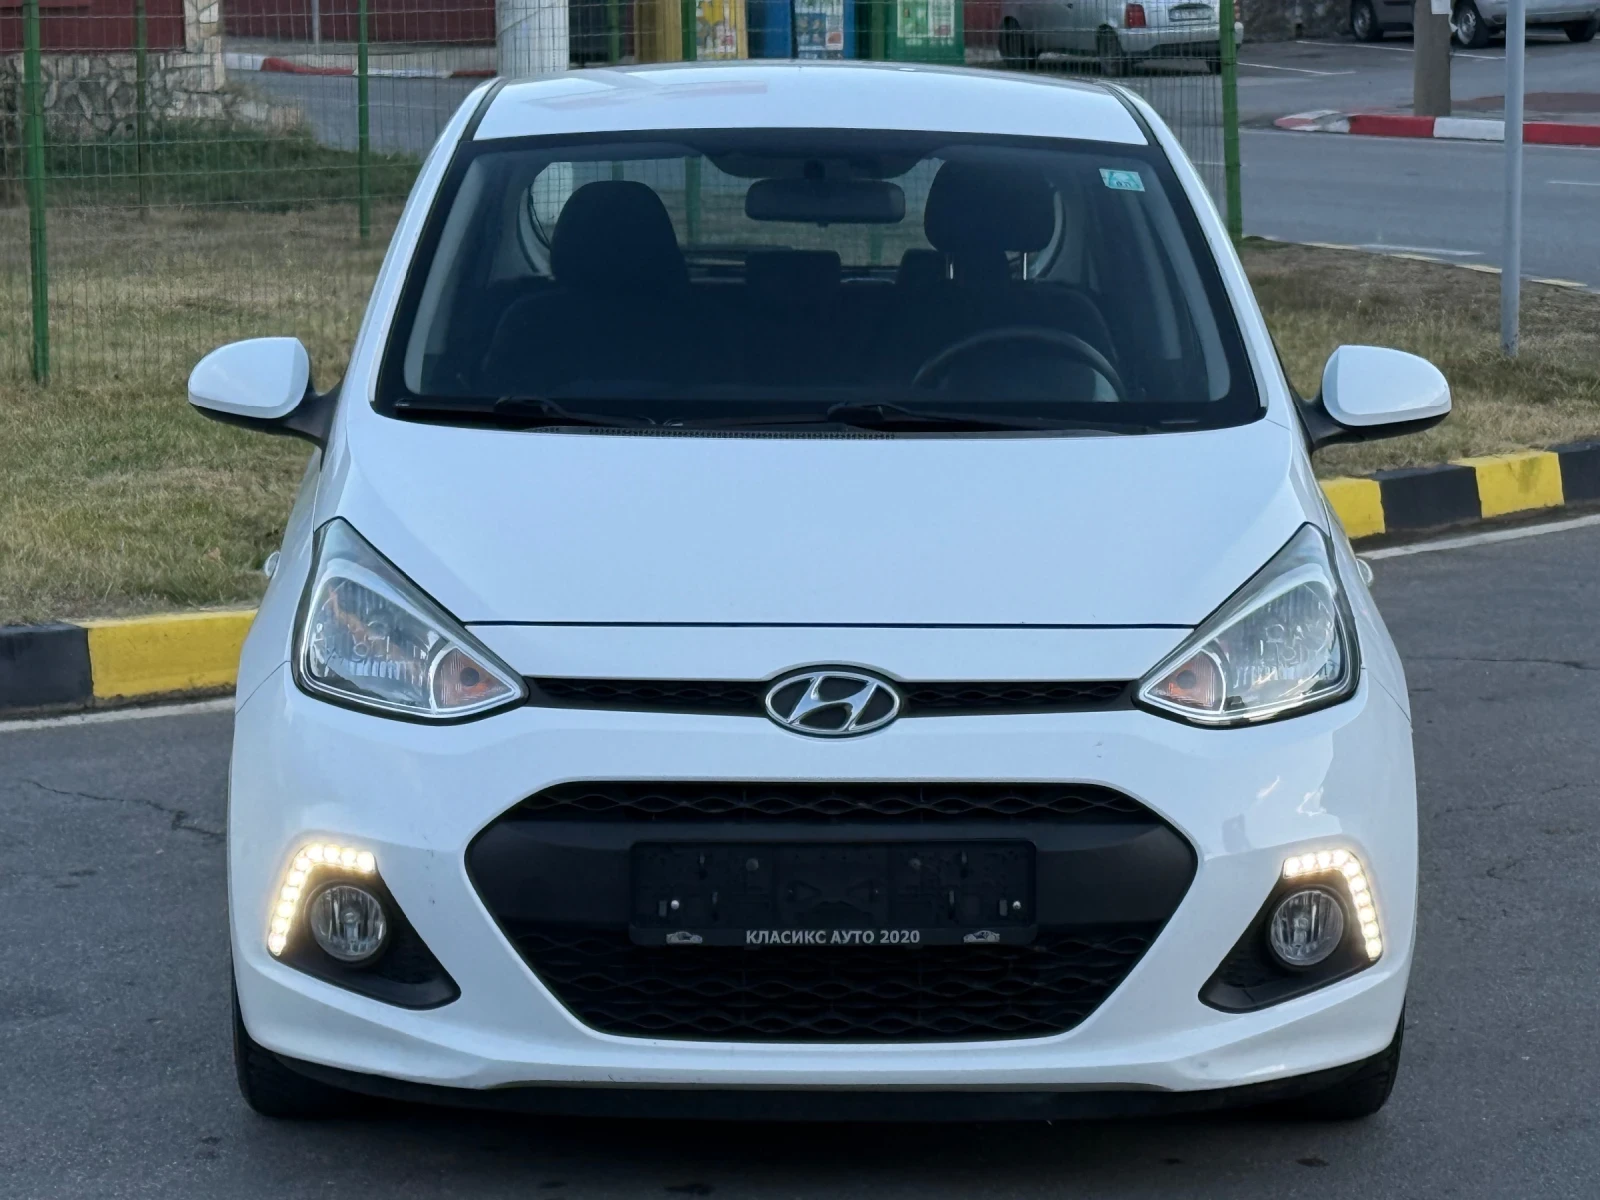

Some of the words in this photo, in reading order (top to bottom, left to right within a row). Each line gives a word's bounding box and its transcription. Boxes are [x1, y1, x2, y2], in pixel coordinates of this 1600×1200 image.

[745, 930, 826, 944] КЛАСИКС
[830, 930, 875, 944] АУТО
[879, 930, 920, 944] 2020
